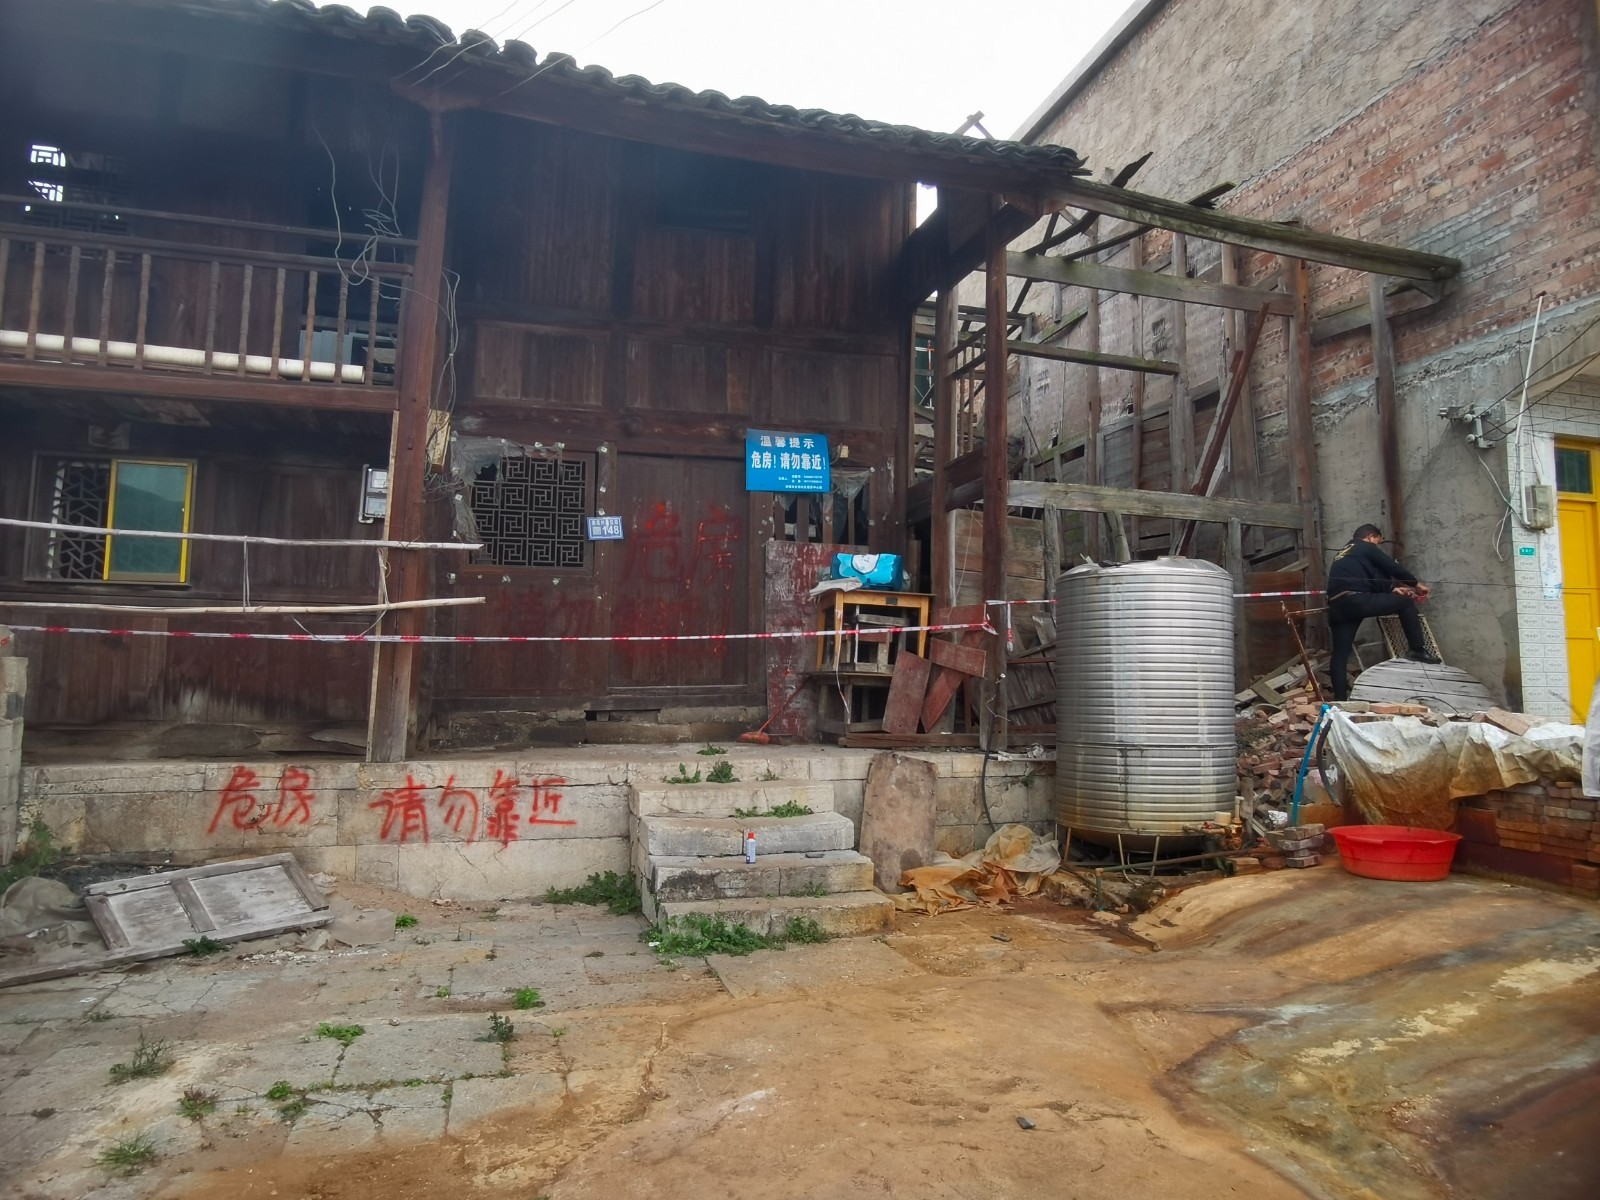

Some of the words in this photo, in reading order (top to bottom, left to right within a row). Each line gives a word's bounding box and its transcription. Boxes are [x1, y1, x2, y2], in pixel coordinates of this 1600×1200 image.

[760, 435, 815, 449] 温馨提示
[602, 525, 620, 536] 148
[620, 502, 740, 591] 危房
[207, 765, 315, 834] 危房
[369, 769, 577, 848] 请勿靠近
